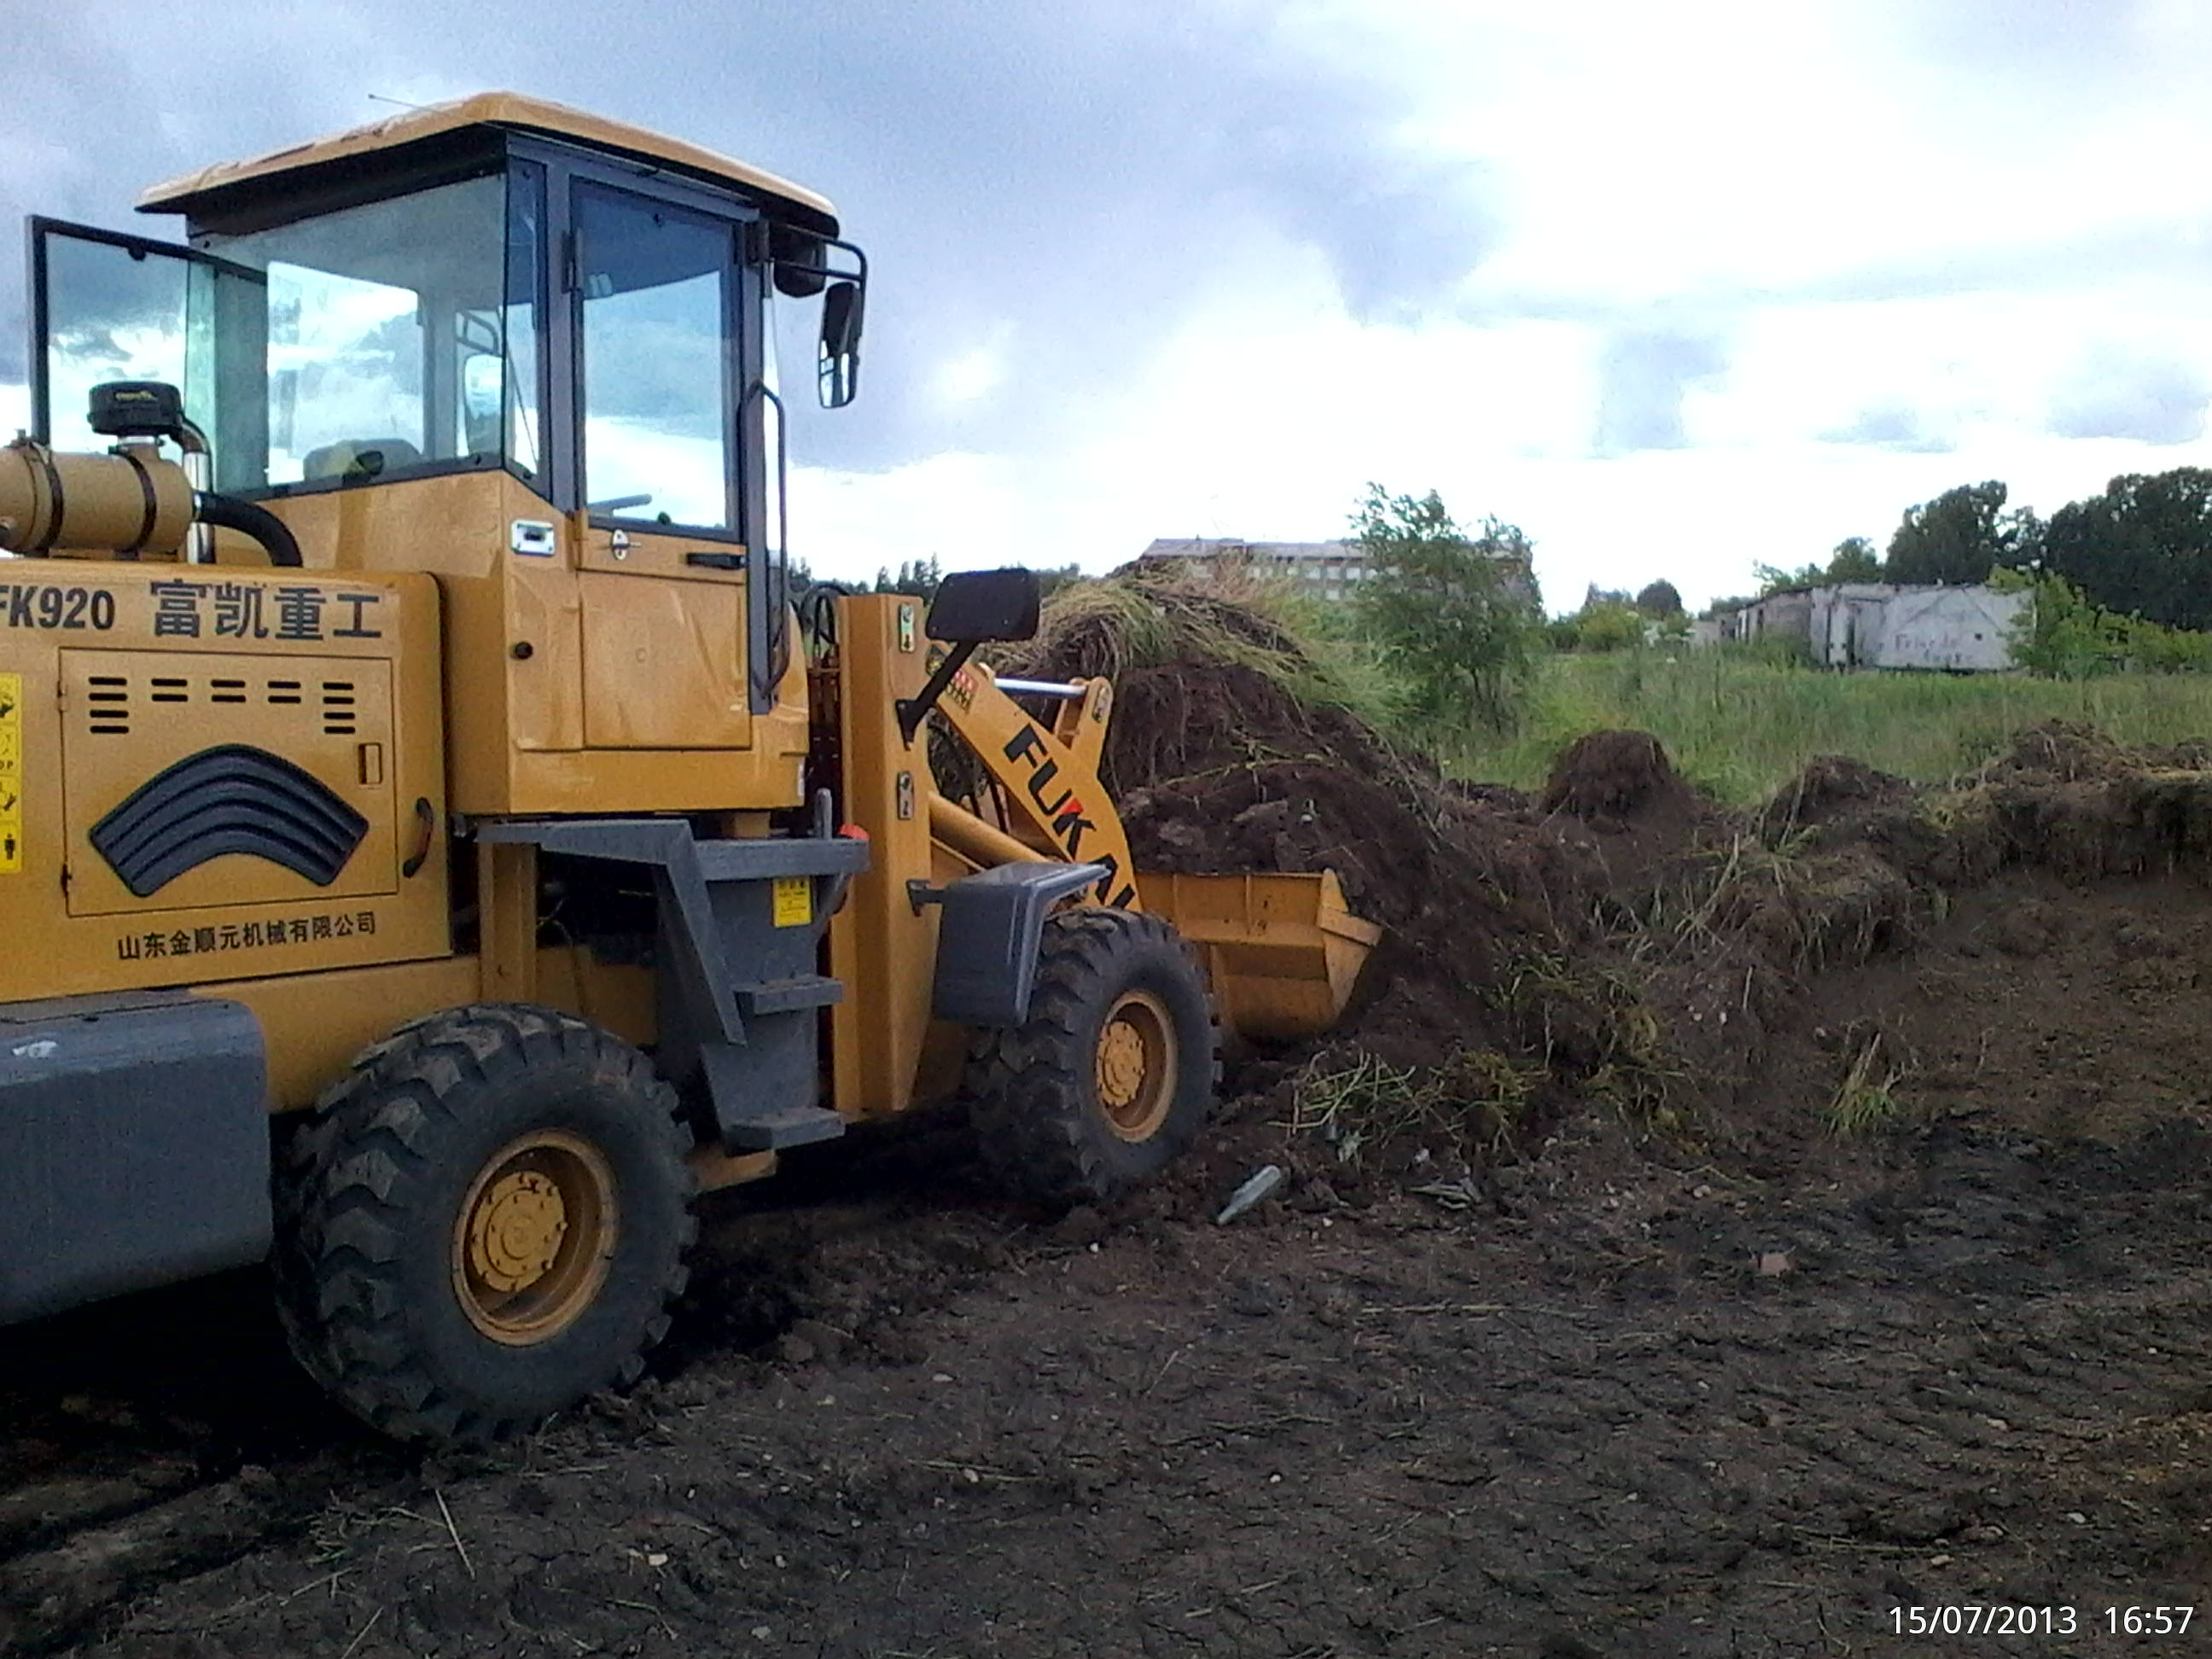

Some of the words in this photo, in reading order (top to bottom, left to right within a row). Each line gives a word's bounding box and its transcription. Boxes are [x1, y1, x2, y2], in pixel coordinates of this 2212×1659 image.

[150, 579, 382, 641] 富凯重工
[118, 911, 376, 960] 山东金顺元机械有限公司
